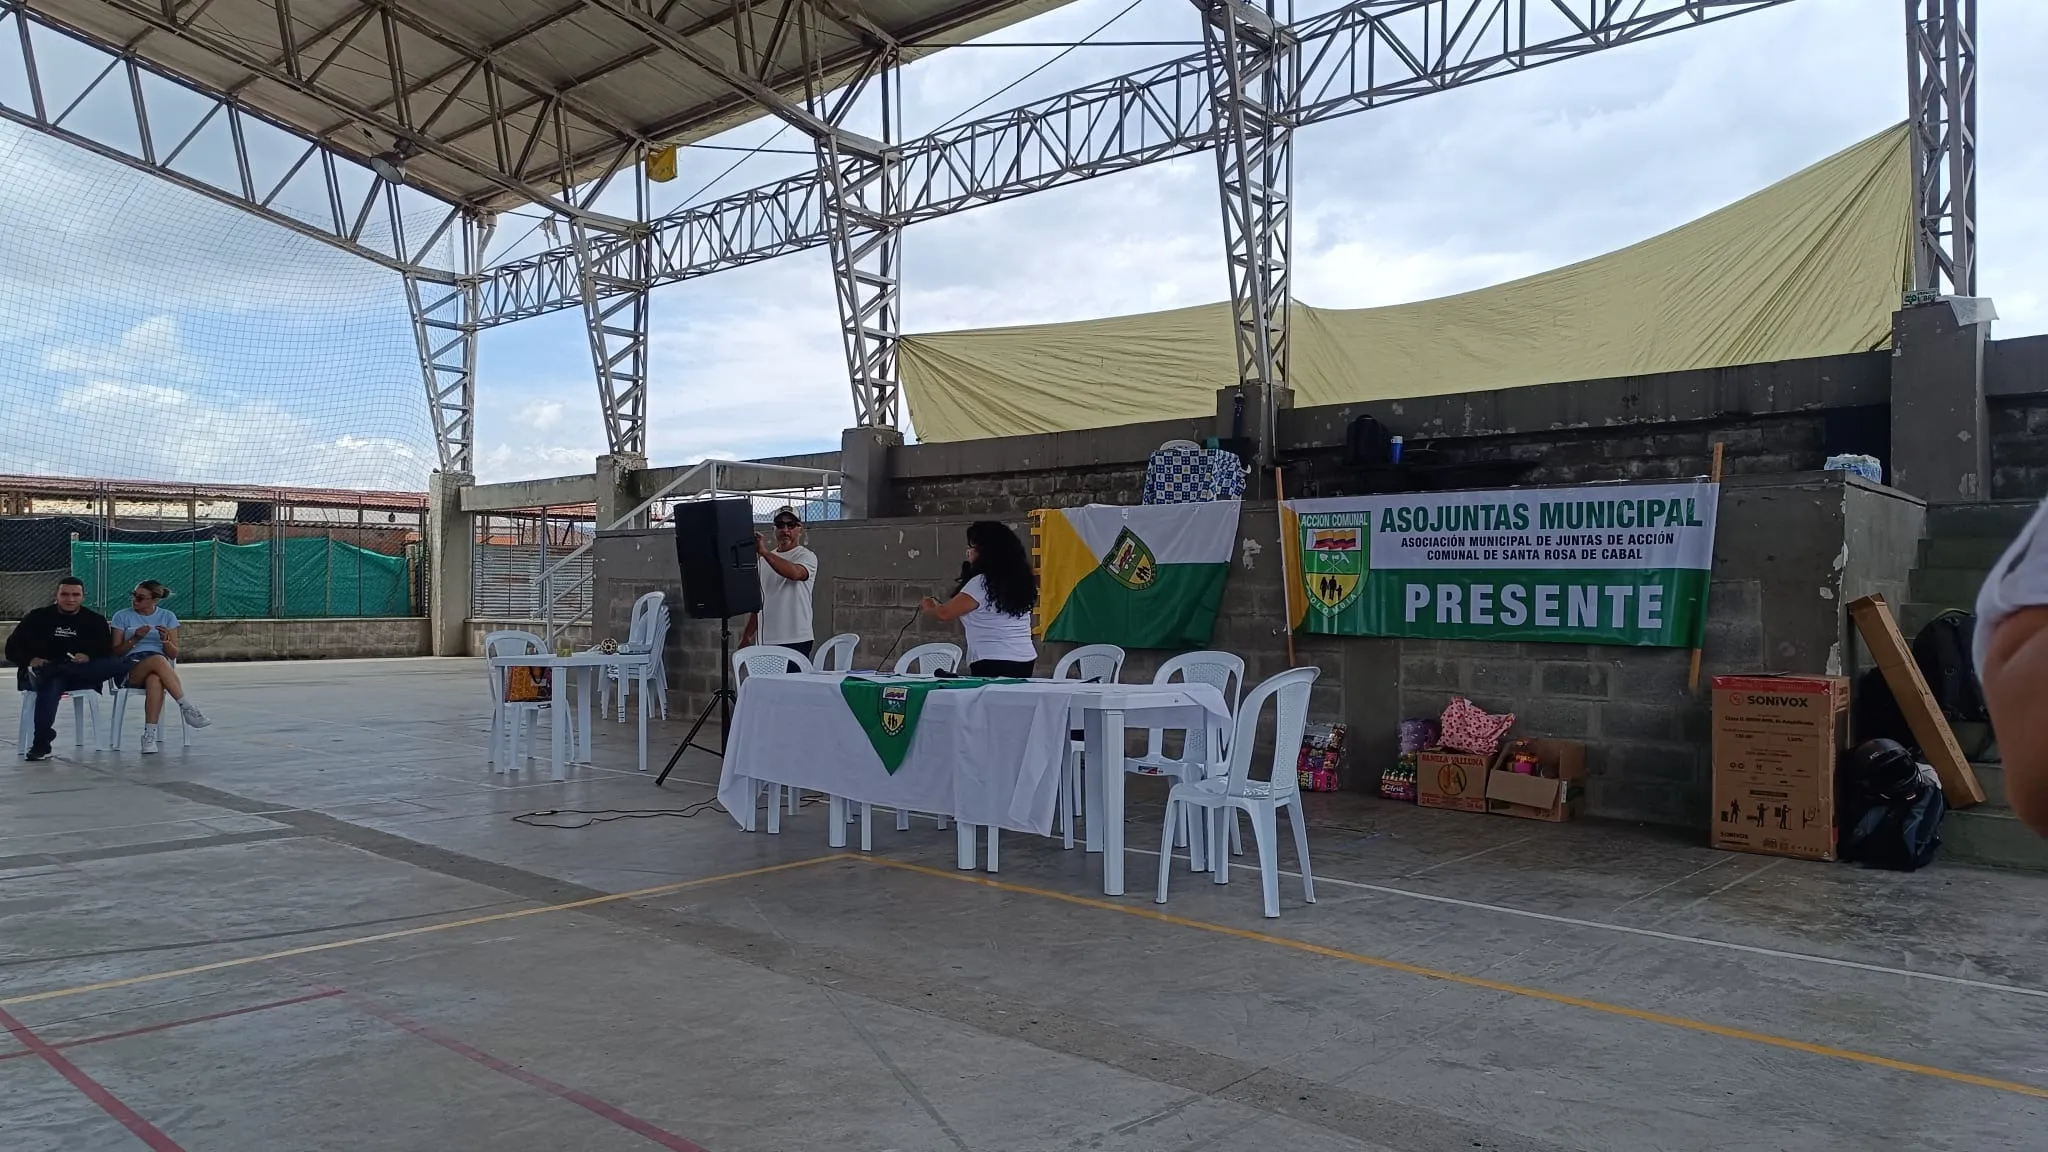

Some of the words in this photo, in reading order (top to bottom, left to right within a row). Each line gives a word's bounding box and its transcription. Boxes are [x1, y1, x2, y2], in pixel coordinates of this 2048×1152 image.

[1301, 515, 1330, 527] ACCION
[1332, 513, 1368, 526] COMUNAL
[1380, 503, 1530, 533] ASOJUNTAS
[1539, 498, 1703, 530] MUNICIPAL
[1401, 534, 1465, 547] ASOCIACIÓN
[1470, 536, 1531, 547] MUNICIPAL
[1536, 535, 1552, 546] DE
[1556, 534, 1602, 546] JUNTAS
[1607, 534, 1623, 545] DE
[1628, 531, 1674, 545] ACCIÓN
[1427, 550, 1480, 561] COMUNAL
[1484, 550, 1498, 560] DE
[1502, 549, 1540, 560] SANTA
[1544, 549, 1577, 560] ROSA
[1581, 549, 1597, 560] DE
[1602, 548, 1643, 560] CABAL
[1405, 583, 1664, 629] PRESENTE
